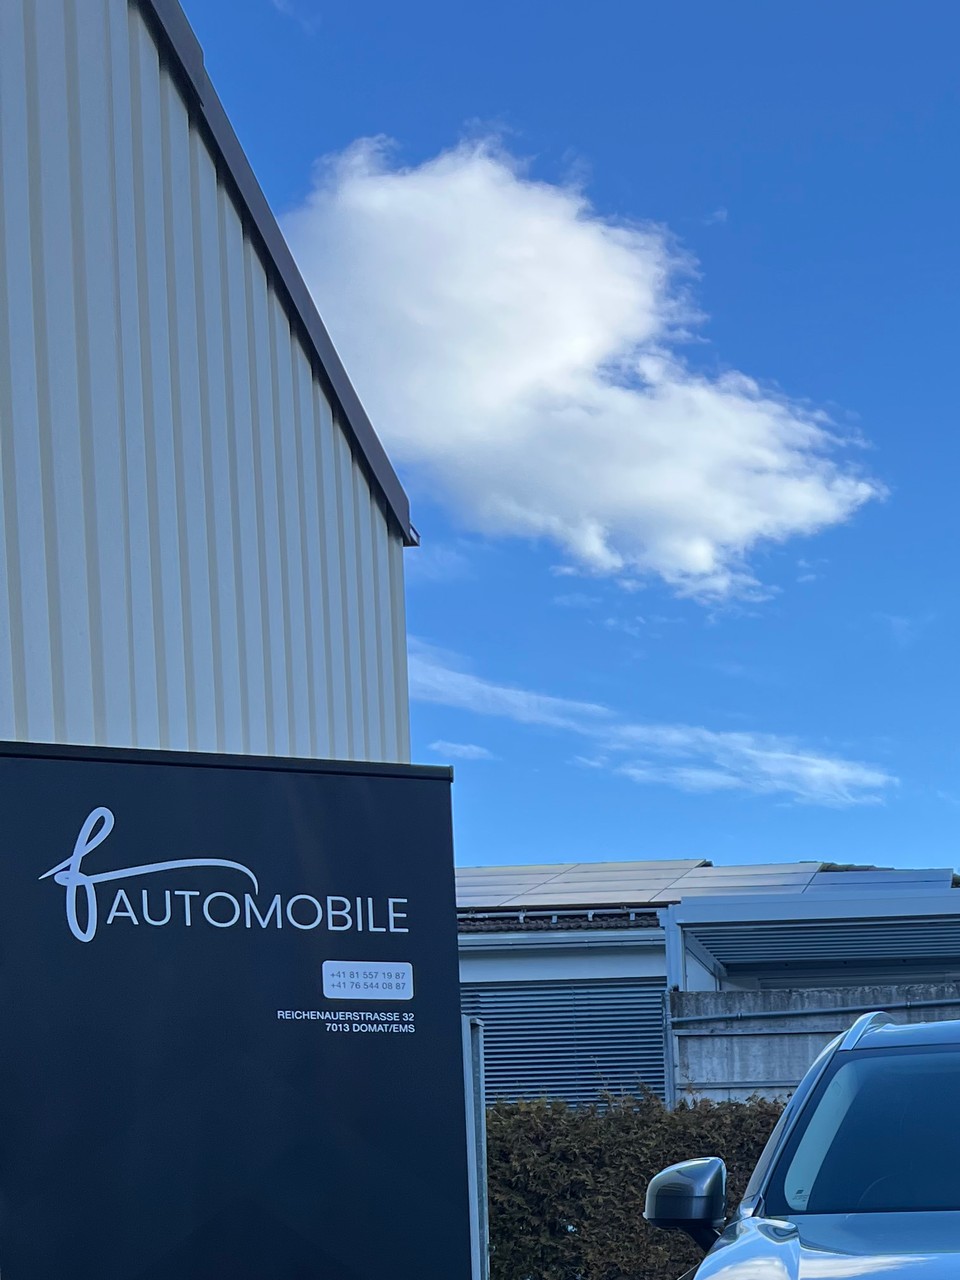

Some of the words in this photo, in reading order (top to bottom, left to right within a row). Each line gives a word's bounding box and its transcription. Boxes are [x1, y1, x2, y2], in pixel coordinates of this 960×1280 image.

[106, 888, 409, 933] AUTOMOBILE
[330, 971, 345, 979] +41
[349, 971, 359, 979] 81
[382, 972, 392, 980] 19
[395, 972, 405, 980] 87
[363, 982, 379, 990] 544
[277, 1010, 400, 1021] REICHENAUERSTRASSE
[402, 1012, 415, 1022] 32
[326, 1023, 350, 1032] 7013
[352, 1024, 416, 1033] DOMAT/EMS
